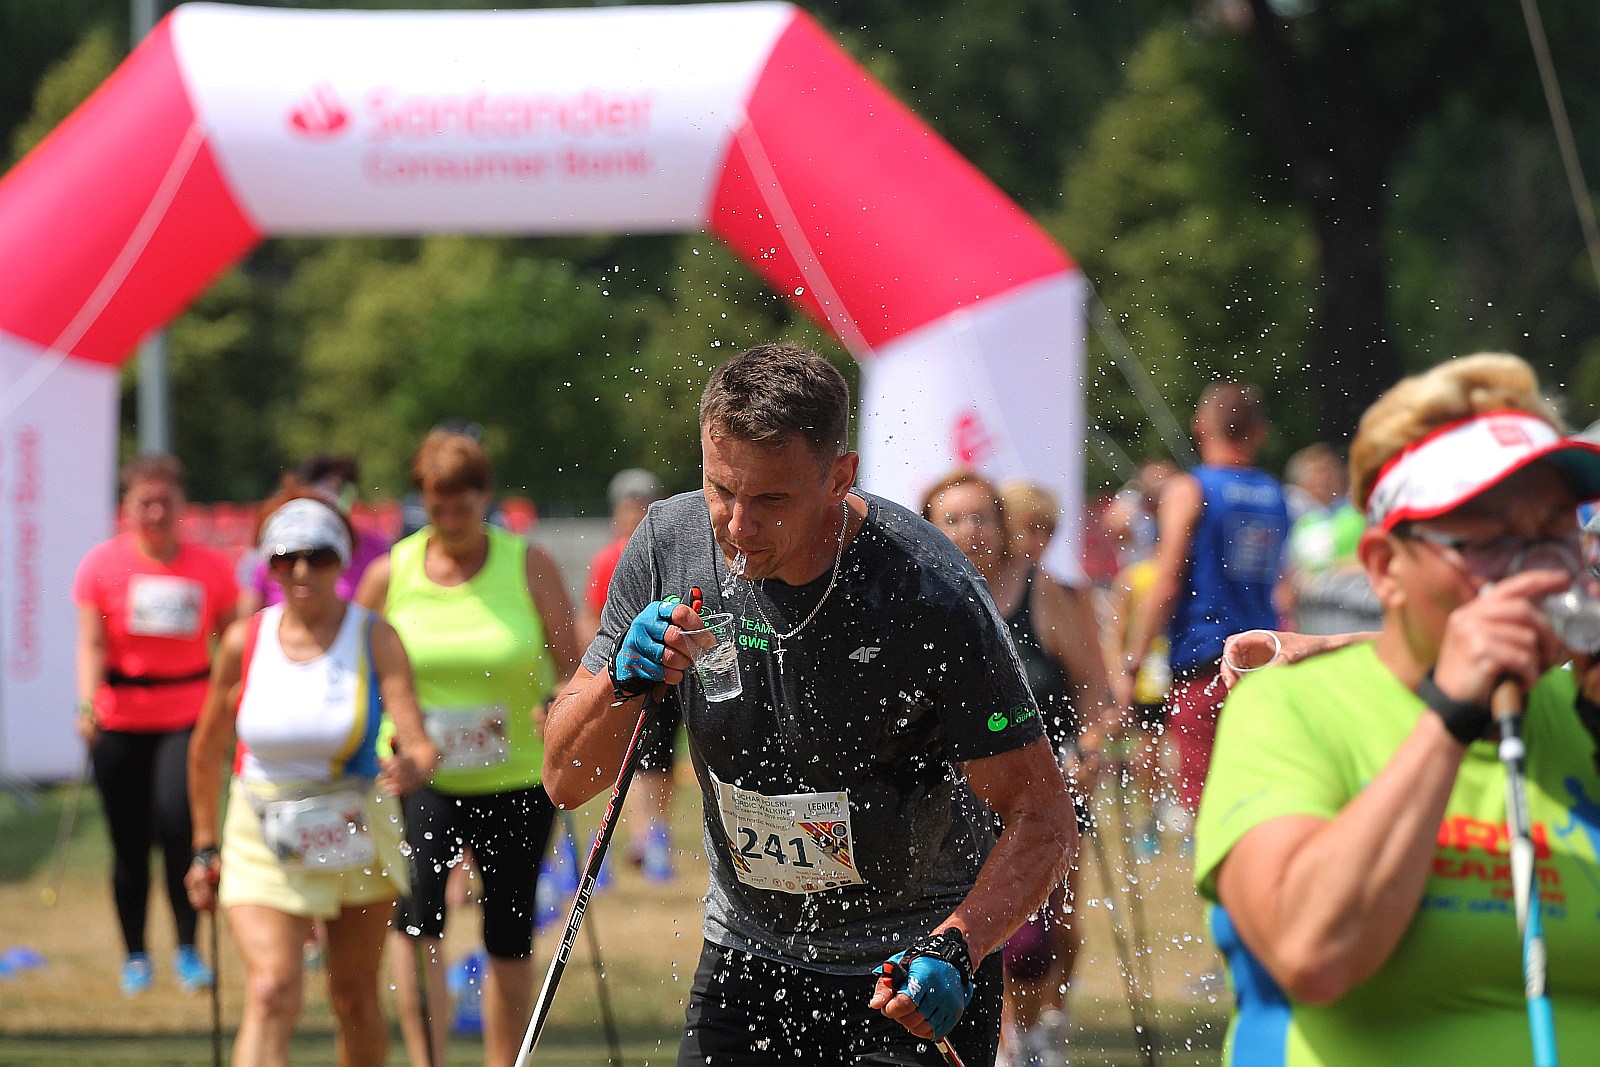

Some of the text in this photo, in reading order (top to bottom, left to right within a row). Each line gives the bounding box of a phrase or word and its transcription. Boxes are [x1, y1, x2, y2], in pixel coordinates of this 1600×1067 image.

[365, 89, 652, 138] Santander
[740, 619, 770, 634] TEAM
[739, 634, 769, 651] GWE
[848, 646, 881, 663] 4F
[735, 792, 761, 803] UCHAR
[738, 827, 814, 868] 241
